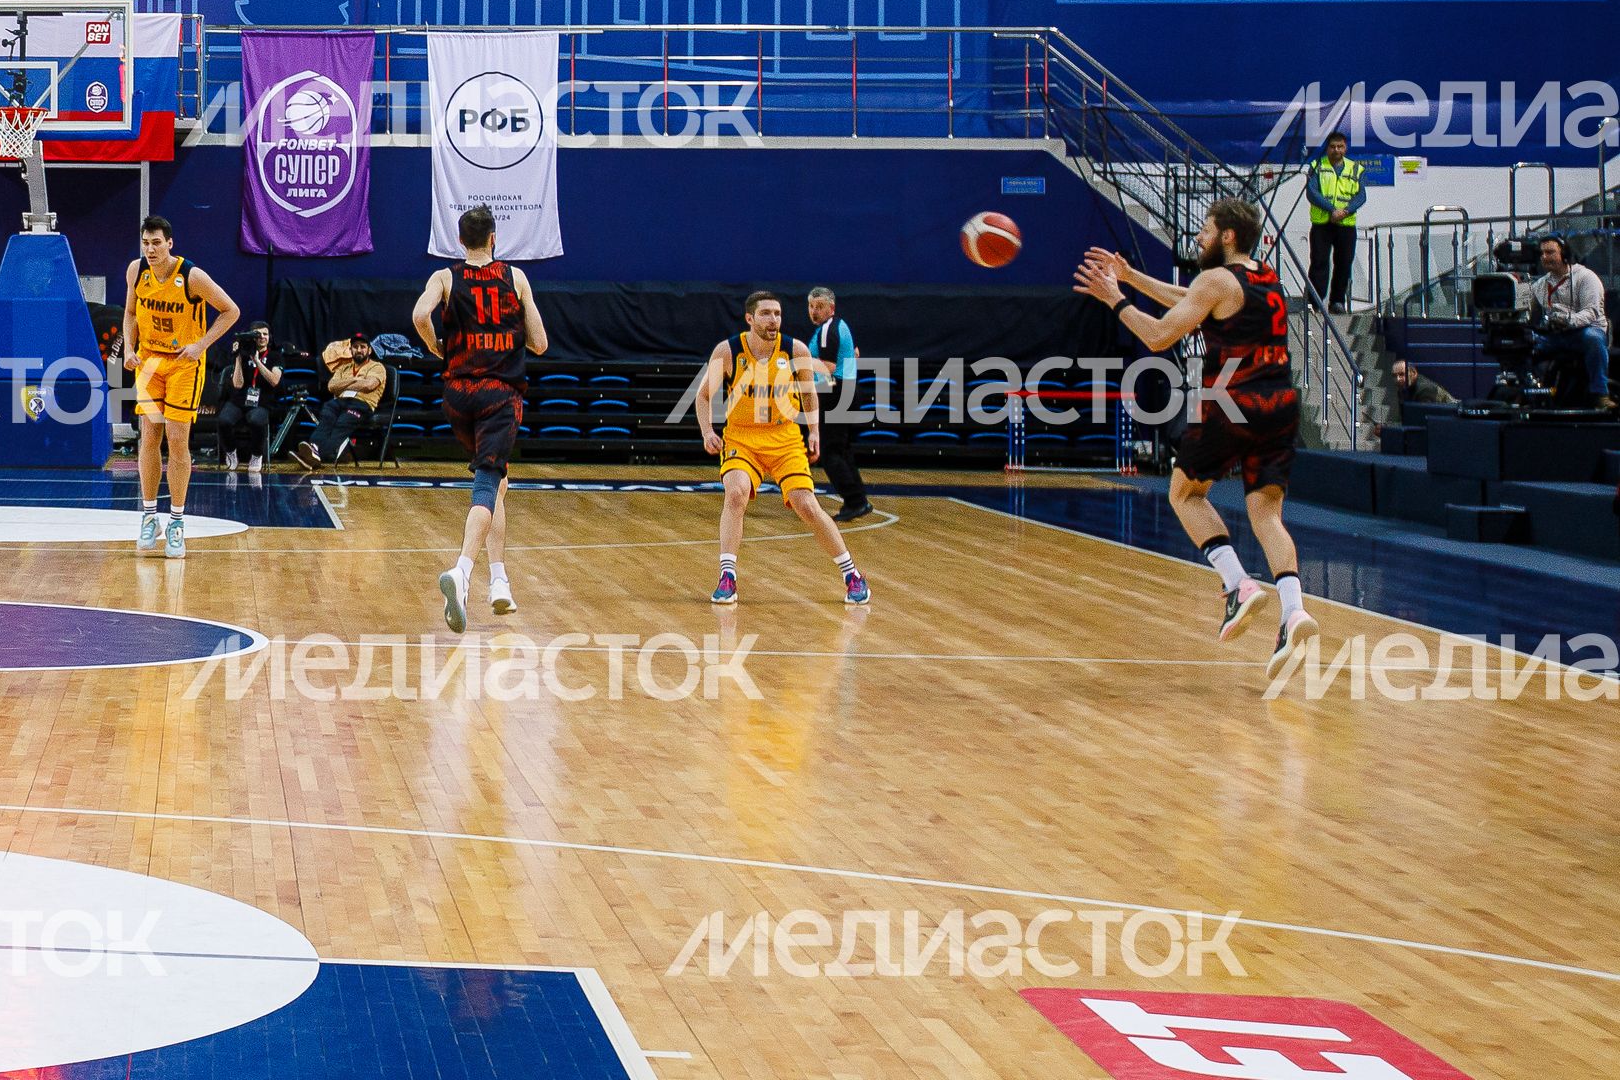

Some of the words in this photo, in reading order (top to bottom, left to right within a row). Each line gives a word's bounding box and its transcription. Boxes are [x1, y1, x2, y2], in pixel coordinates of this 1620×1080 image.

[86, 24, 109, 33] FON
[86, 33, 108, 42] BET
[459, 100, 531, 134] РФБ
[277, 138, 337, 152] FONBET
[274, 153, 340, 185] СУПЕР
[286, 187, 328, 198] ЛИГА
[467, 194, 523, 202] РОССИЙСКАЯ
[139, 297, 184, 314] ХИМКИ
[471, 286, 501, 325] 11
[1266, 291, 1287, 335] 2
[152, 315, 174, 334] 99
[107, 333, 124, 366] Dr.Dis
[467, 333, 513, 351] РЕВДА
